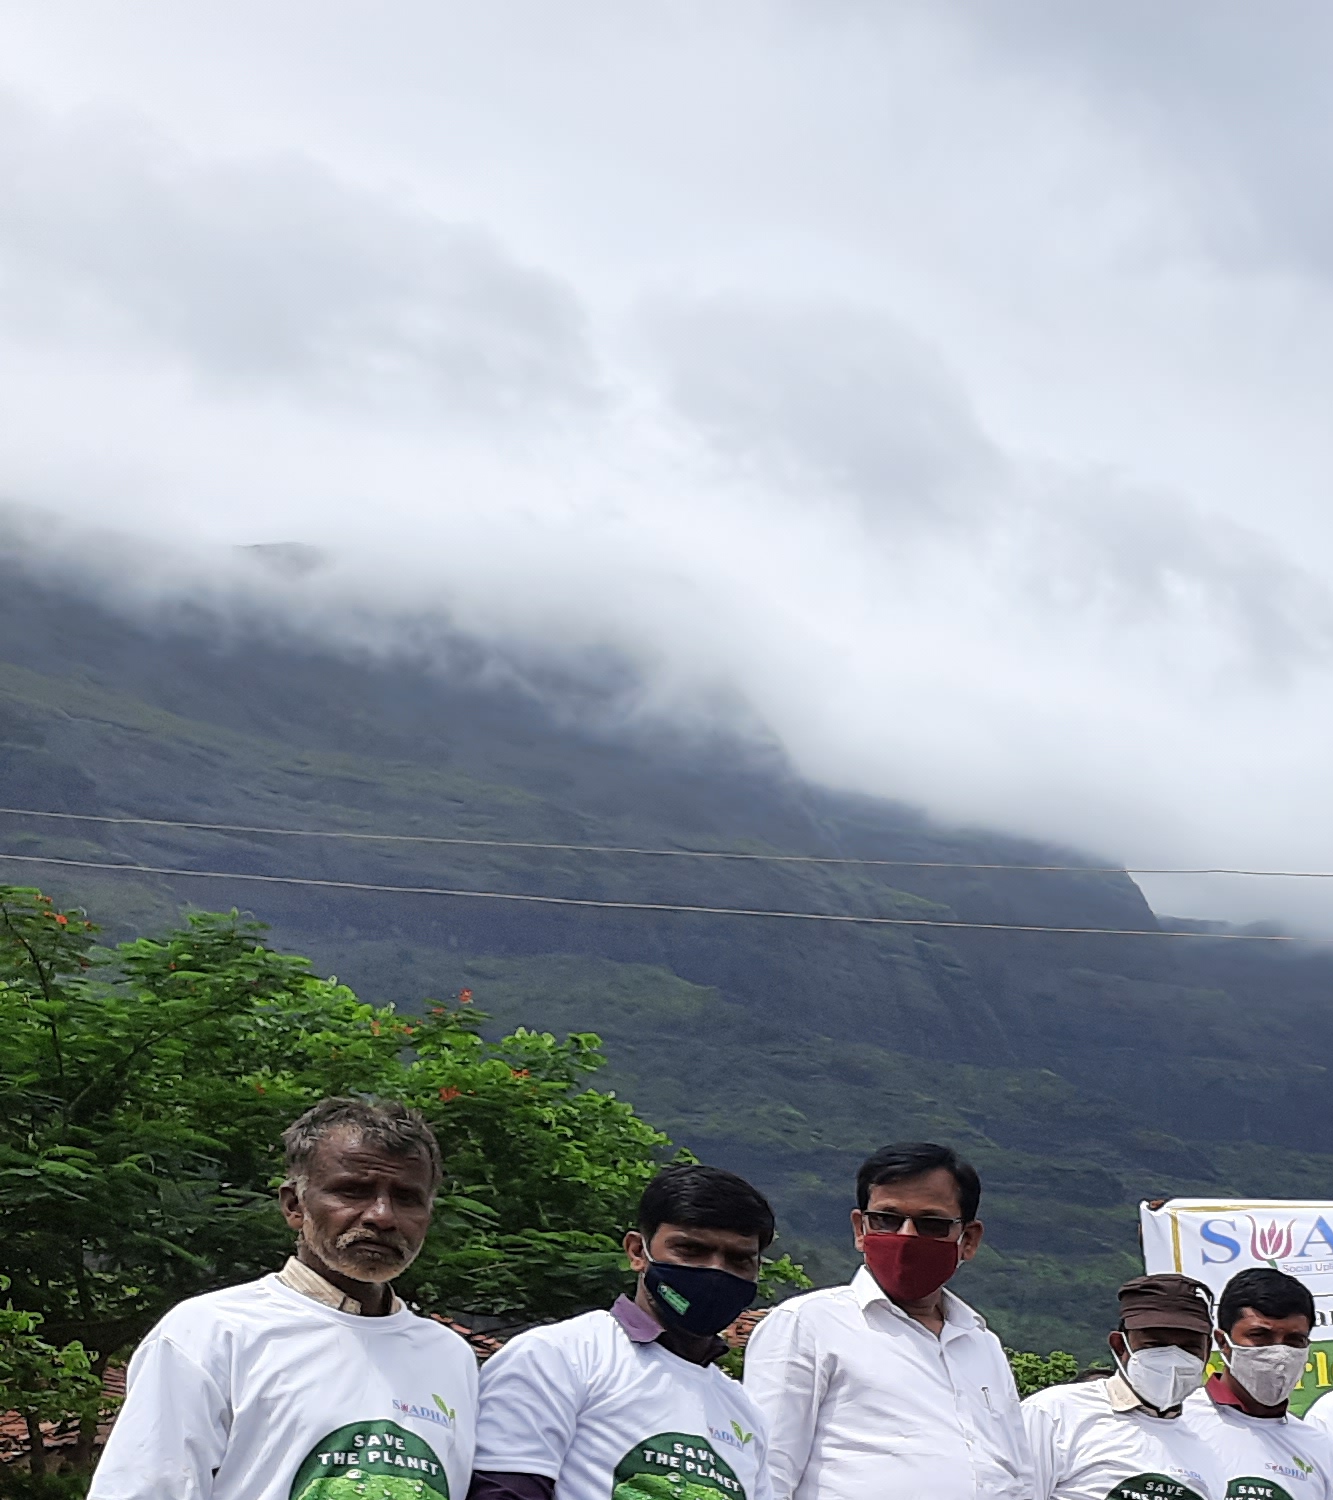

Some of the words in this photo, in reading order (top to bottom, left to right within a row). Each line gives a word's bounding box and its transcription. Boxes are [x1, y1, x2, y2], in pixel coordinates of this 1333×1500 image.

[353, 1433, 406, 1450] SAVE
[317, 1452, 360, 1465] THE
[368, 1450, 439, 1477] PLANET
[643, 1450, 681, 1468] THE
[685, 1460, 741, 1492] PLANET
[1145, 1481, 1185, 1496] SAVE
[1238, 1485, 1274, 1498] SAVE
